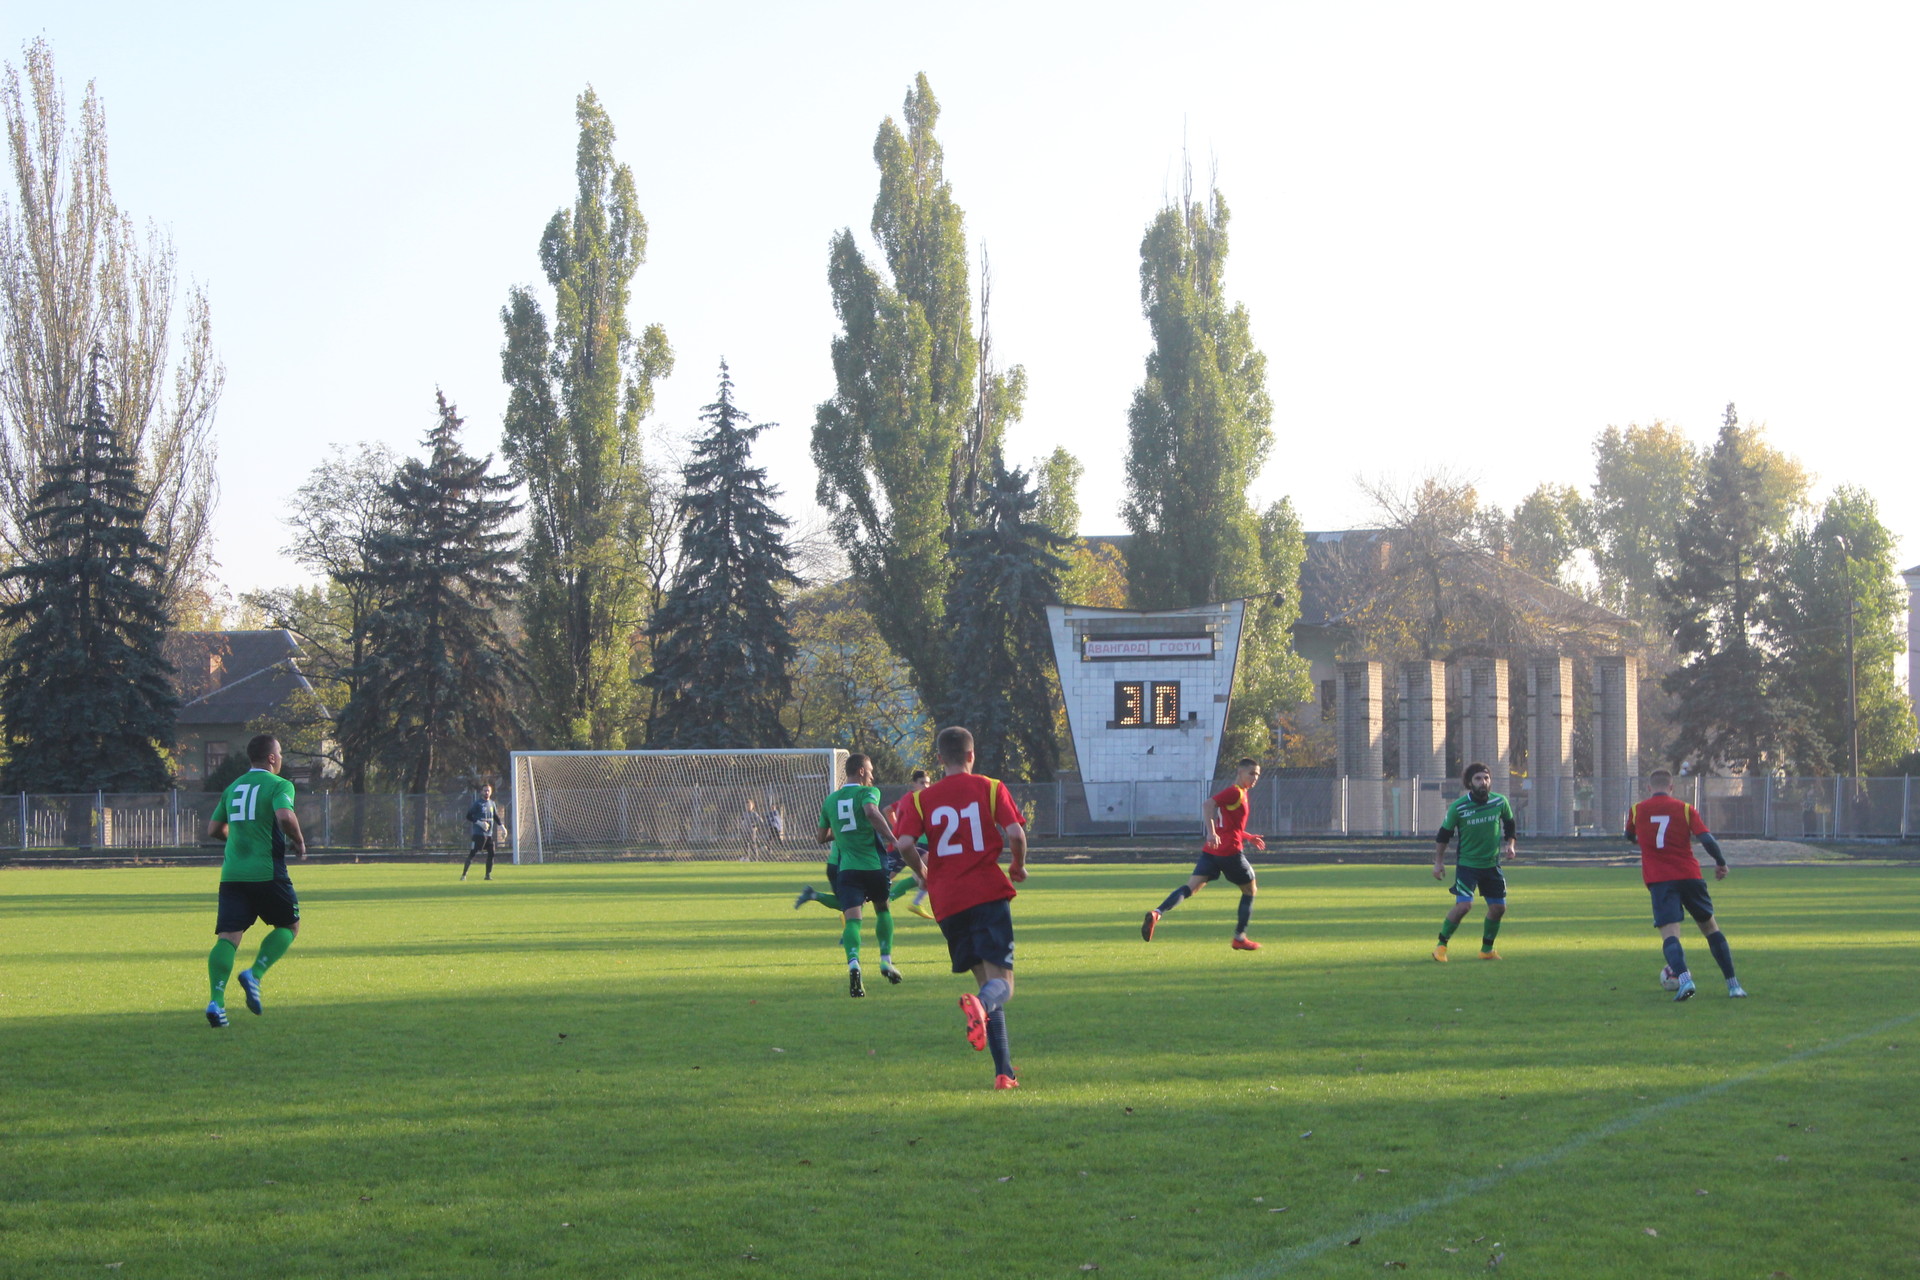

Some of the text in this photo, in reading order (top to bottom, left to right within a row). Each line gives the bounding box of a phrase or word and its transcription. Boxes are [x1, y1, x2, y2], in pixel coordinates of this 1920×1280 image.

[1087, 641, 1201, 654] АВАНГАРД ГОСТИ
[1120, 686, 1176, 724] 3 0
[229, 783, 260, 822] 31
[837, 798, 857, 832] 9
[931, 801, 984, 857] 21
[1650, 815, 1670, 849] 7
